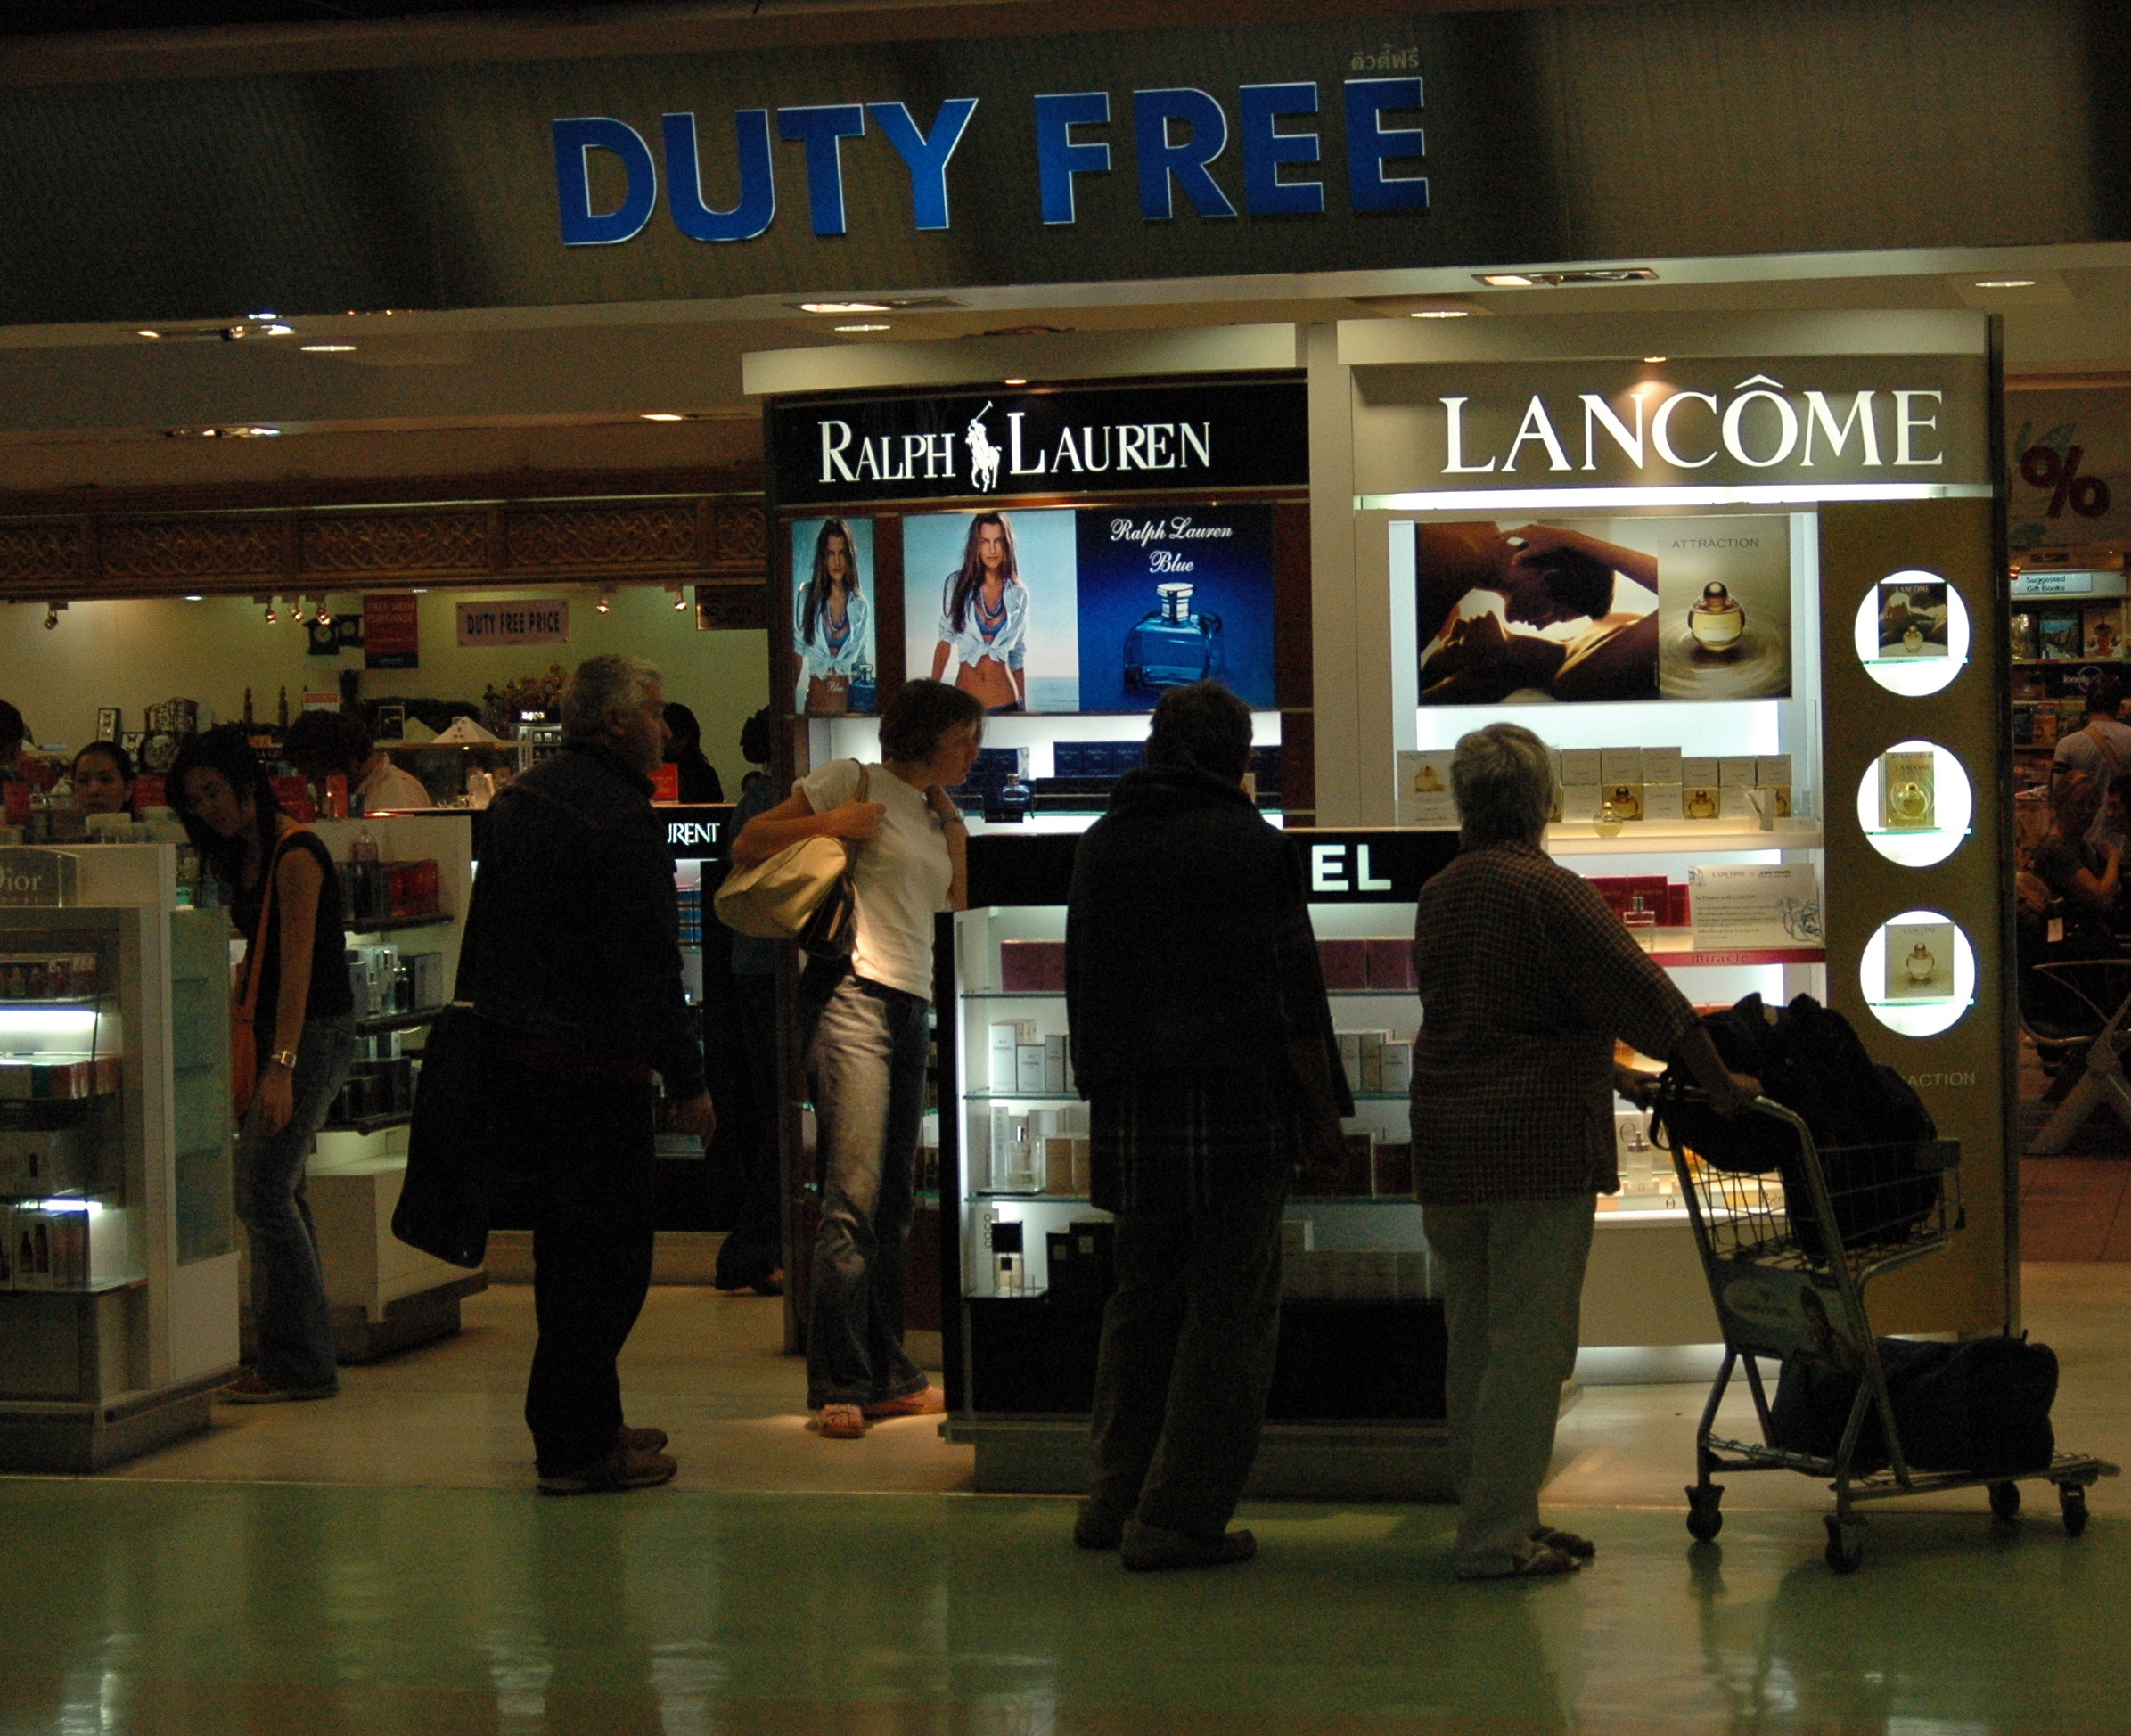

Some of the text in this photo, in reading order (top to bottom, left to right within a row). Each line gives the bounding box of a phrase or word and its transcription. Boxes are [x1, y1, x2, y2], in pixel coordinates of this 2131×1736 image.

[552, 77, 1429, 246] DUTY FREE
[1439, 373, 1944, 474] LANCÔME
[817, 411, 1211, 484] RALPH LAUREN
[1111, 517, 1234, 547] Ralph Lauren
[1672, 537, 1760, 549] ATTRACTION
[1149, 550, 1194, 573] Blue
[467, 611, 560, 635] DUTY FREE PRICE
[1692, 952, 1749, 963] miracle
[1908, 1072, 1976, 1087] ACTION
